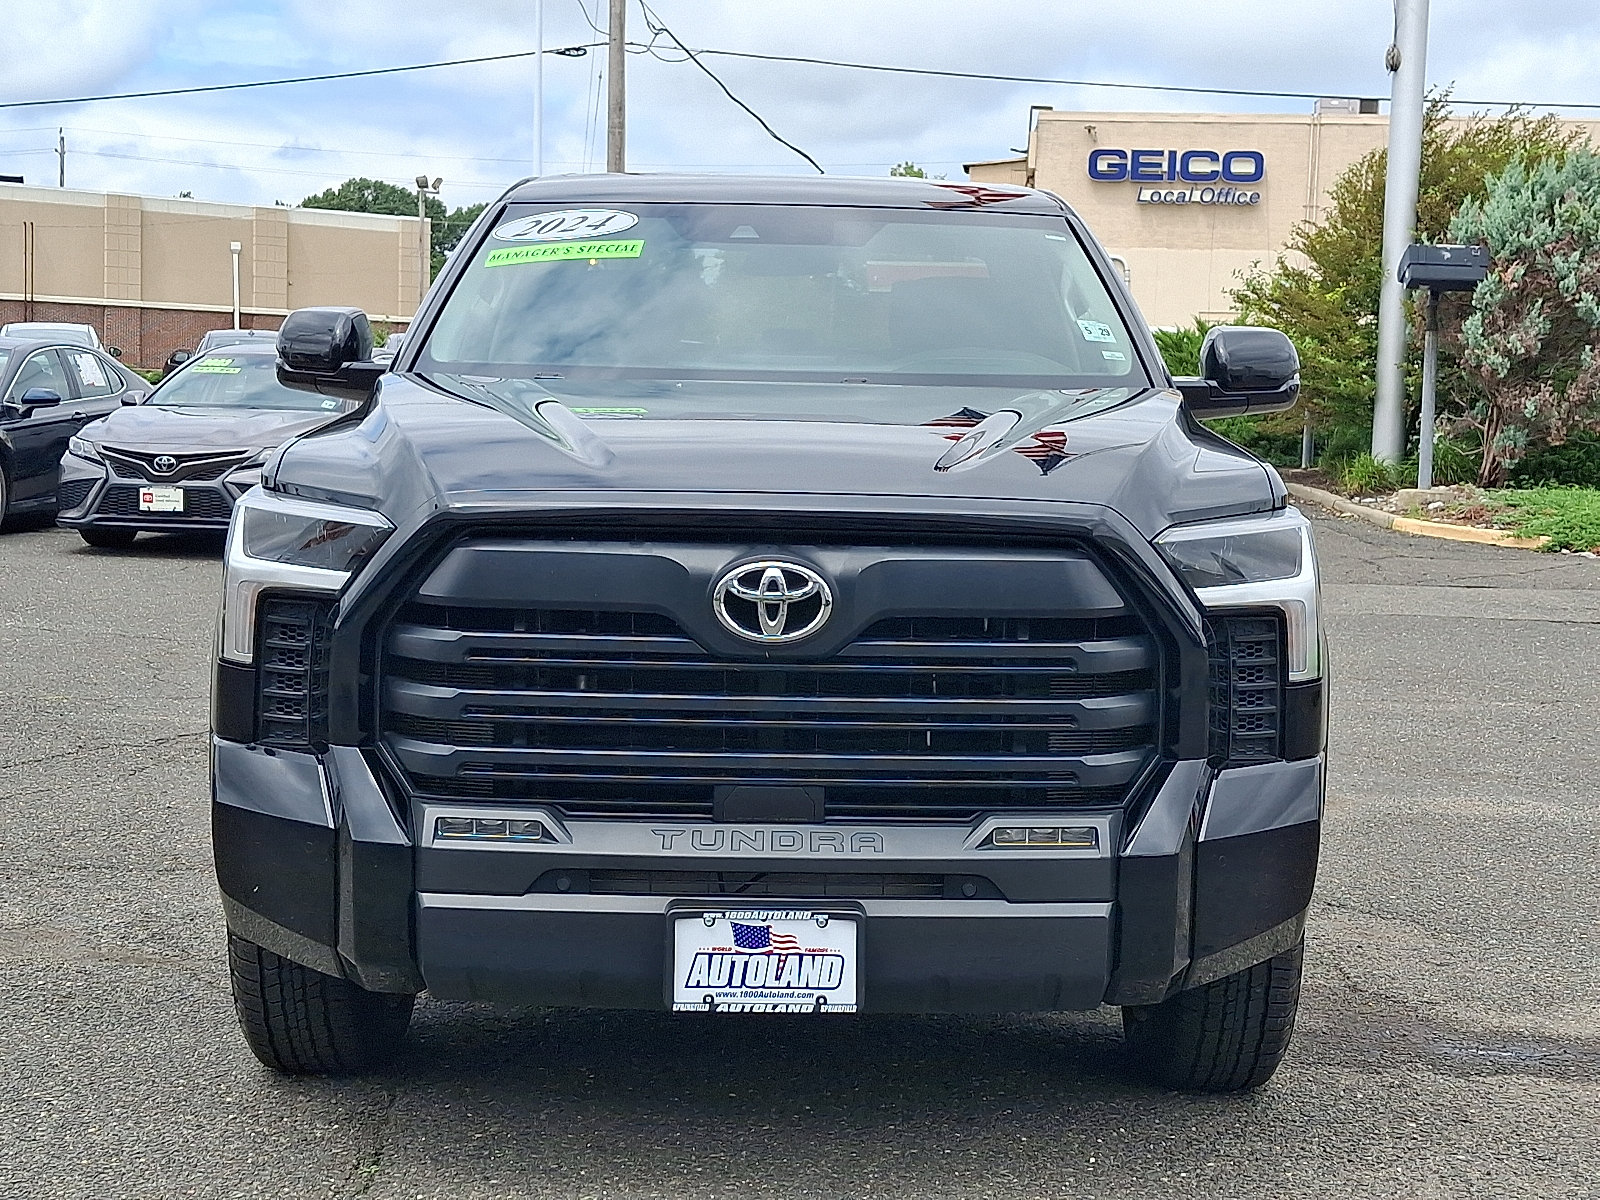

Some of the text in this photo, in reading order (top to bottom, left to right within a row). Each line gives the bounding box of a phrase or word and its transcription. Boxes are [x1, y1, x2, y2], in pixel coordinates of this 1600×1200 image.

[1088, 149, 1265, 183] GEICO
[1136, 186, 1261, 205] Local Office
[510, 214, 618, 238] 2024
[488, 246, 573, 262] MANAGER'S
[651, 829, 884, 853] TUNDRA
[684, 952, 844, 990] AUTOLAND
[715, 990, 815, 999] www.1800Autoland.com
[715, 1003, 815, 1013] AUTOLAND
